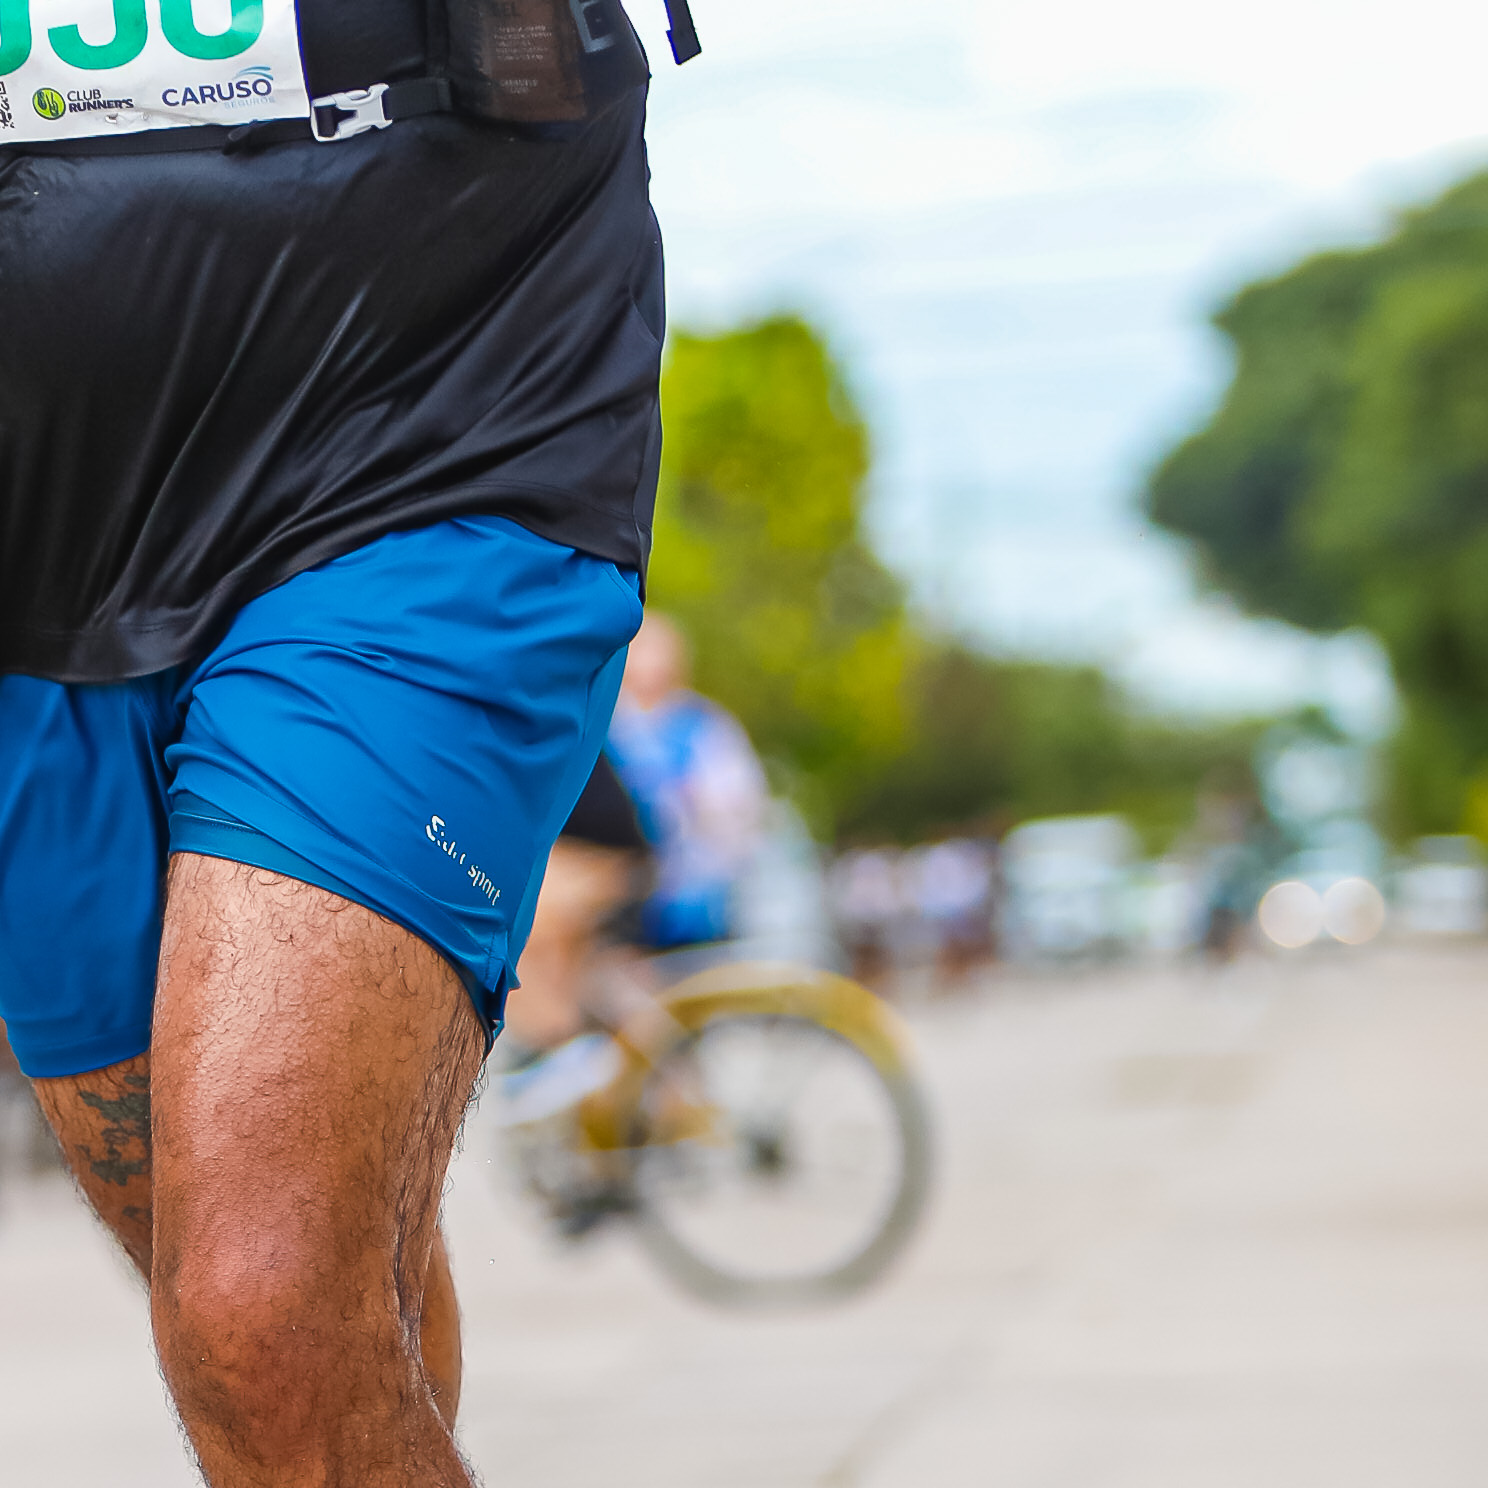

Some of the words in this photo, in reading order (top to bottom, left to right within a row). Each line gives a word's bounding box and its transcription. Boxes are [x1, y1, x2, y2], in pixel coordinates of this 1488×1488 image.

[67, 87, 102, 102] CLUB
[161, 78, 272, 107] CARUSO
[68, 97, 134, 113] RUNNER'S
[223, 95, 277, 111] SEGUROS
[467, 863, 503, 907] sport
